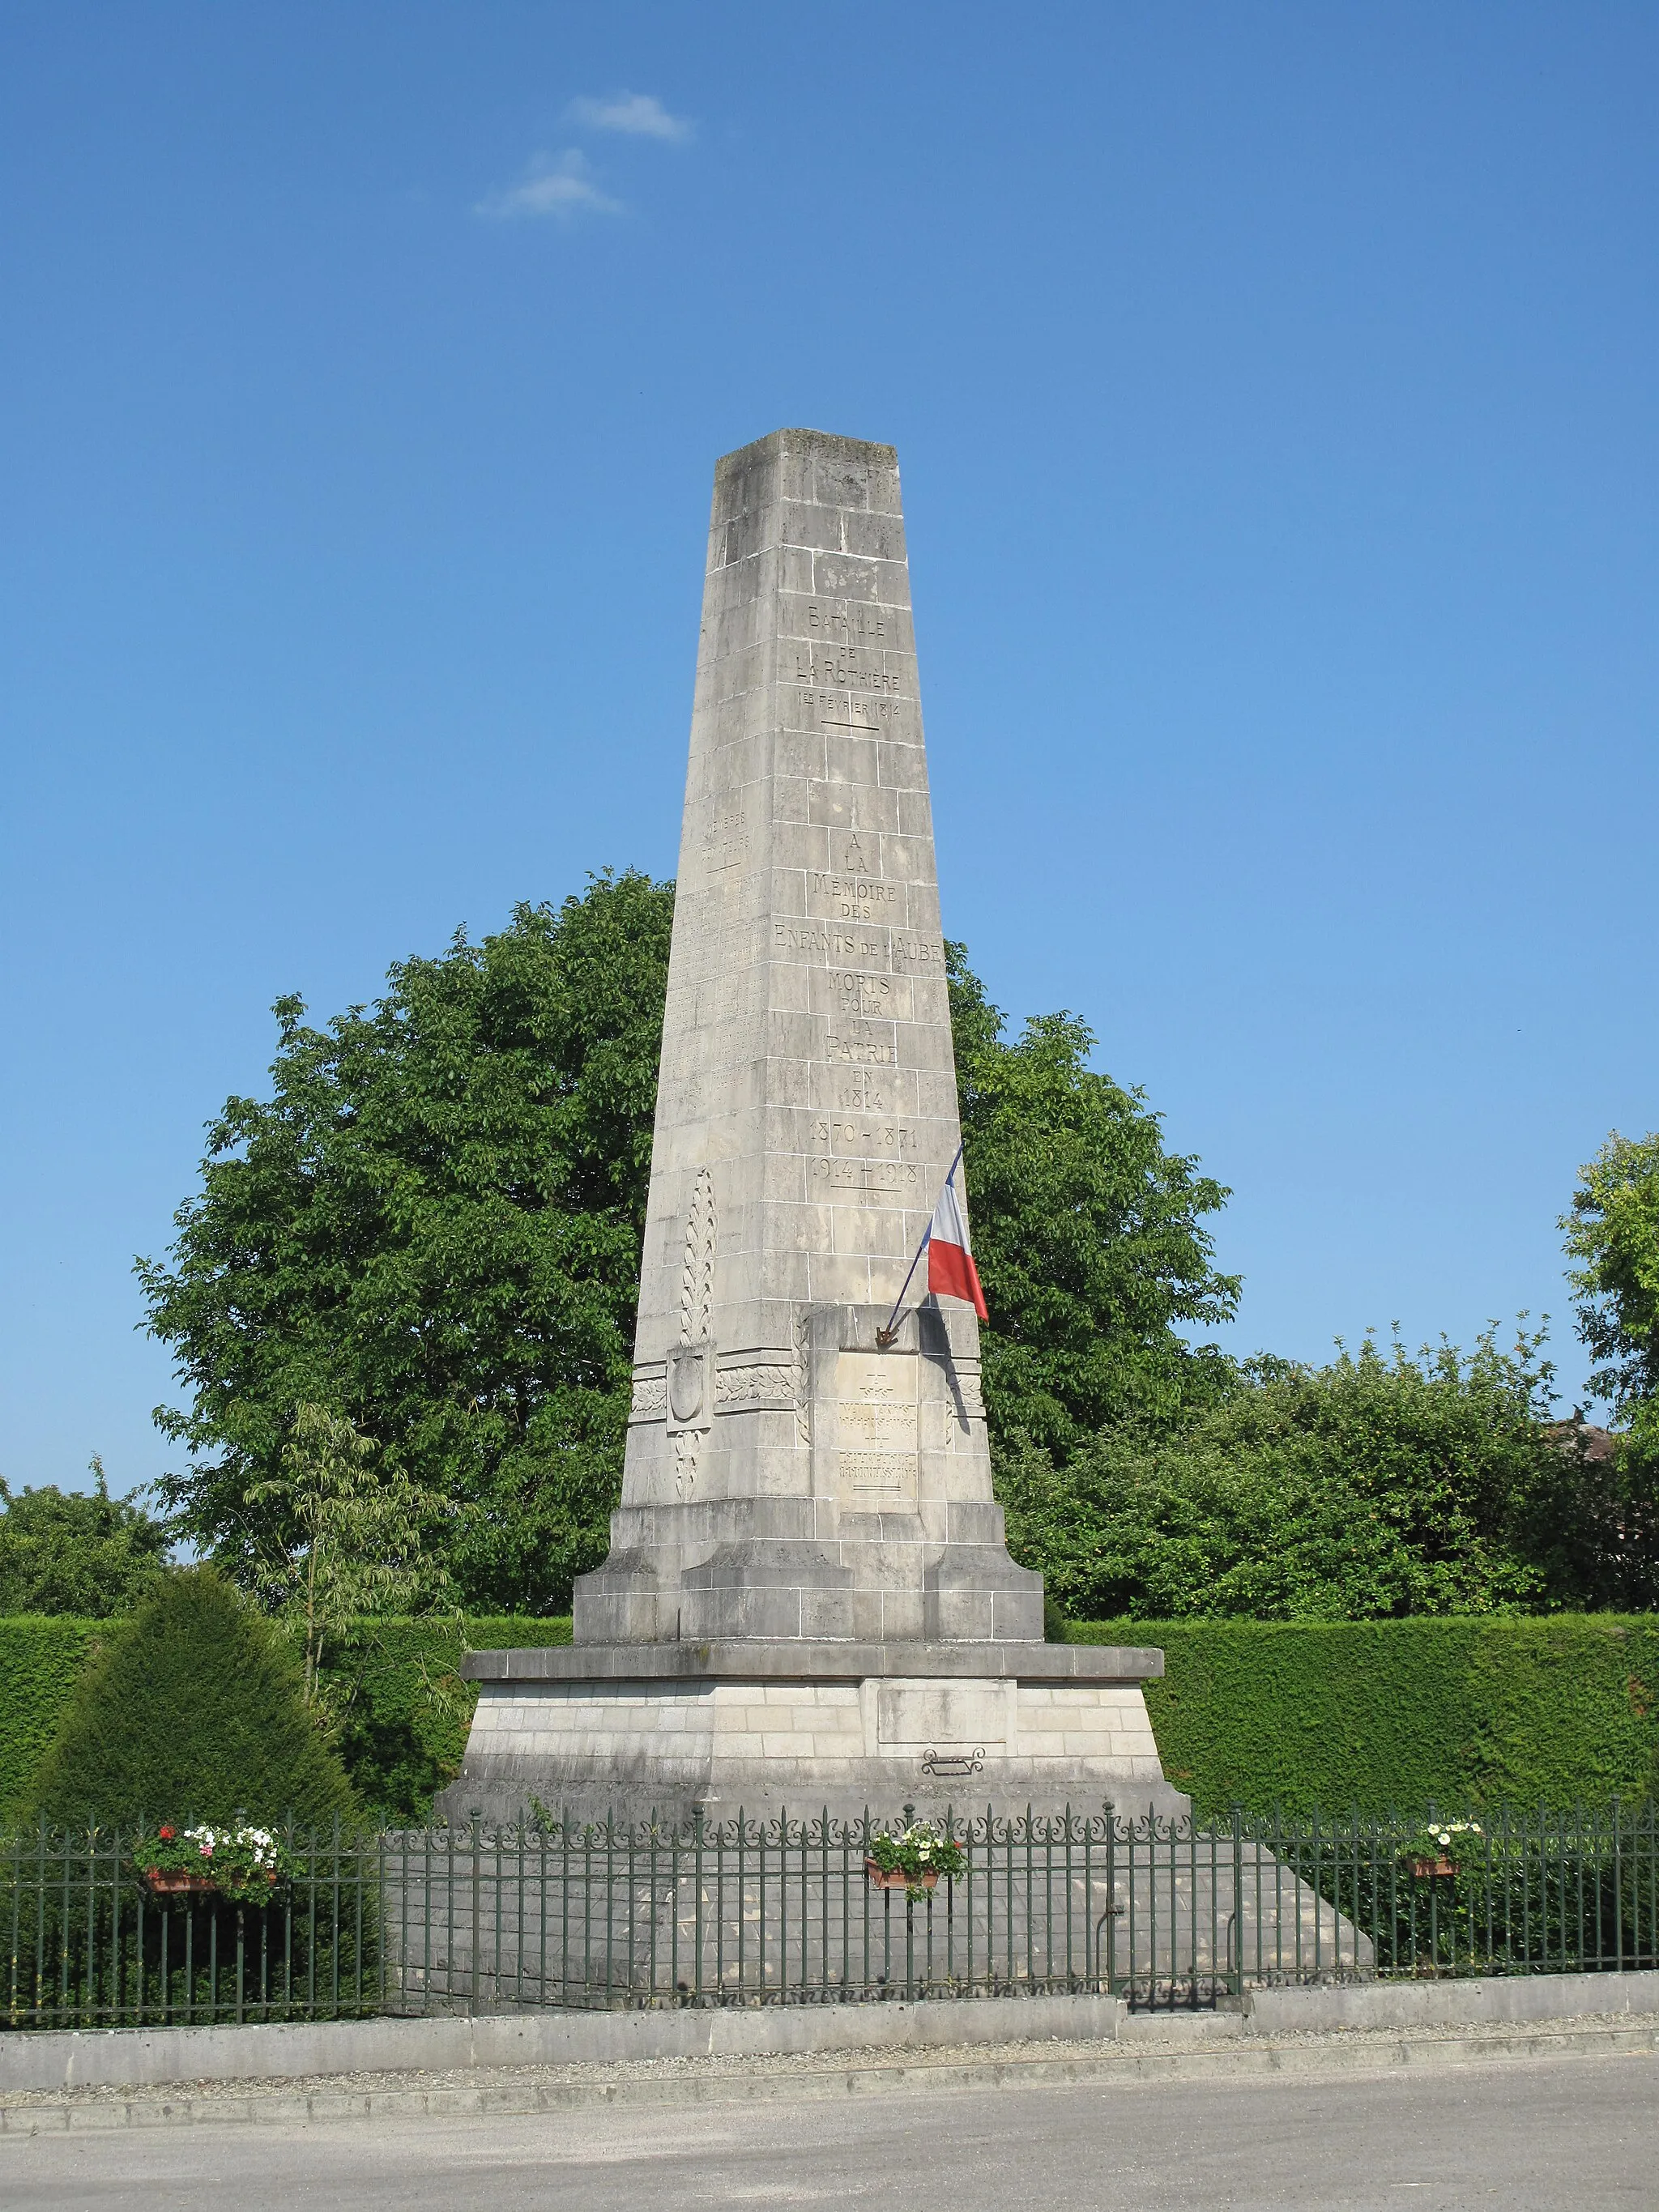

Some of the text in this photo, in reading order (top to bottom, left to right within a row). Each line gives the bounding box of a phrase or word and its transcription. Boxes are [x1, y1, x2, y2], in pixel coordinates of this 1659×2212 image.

[808, 606, 885, 637] BATAILLE
[840, 647, 855, 658] DE
[797, 657, 900, 690] LA ROTHIÈRE
[845, 855, 869, 872] LA
[813, 873, 896, 902] MÉMOIRE
[841, 903, 871, 918] DES
[774, 924, 855, 954] ENFANTS
[860, 944, 878, 956] DE
[829, 972, 890, 995] MORTS
[842, 997, 882, 1016] POUR
[851, 1021, 873, 1035] LA
[825, 1035, 898, 1063] PATRIE
[852, 1071, 872, 1083] EN
[844, 1089, 883, 1109] 1814
[810, 1121, 855, 1142] 1870
[876, 1127, 917, 1148] 1871
[811, 1157, 853, 1179] 1914
[878, 1163, 918, 1183] 1918
